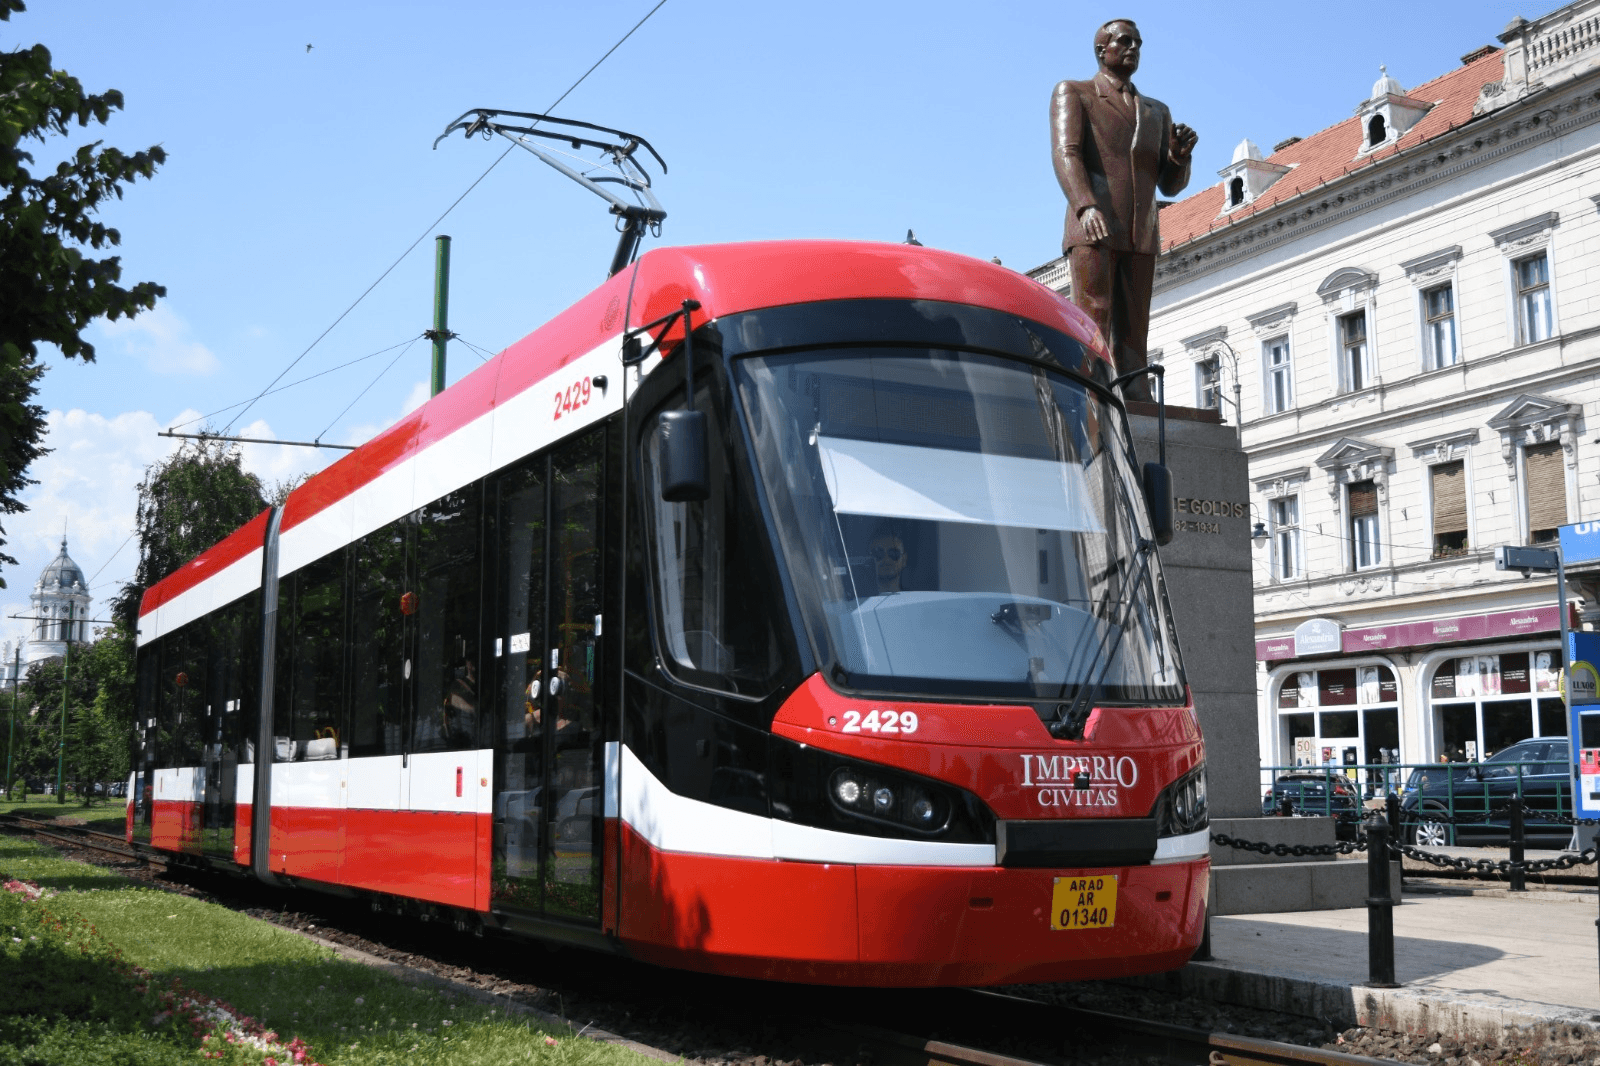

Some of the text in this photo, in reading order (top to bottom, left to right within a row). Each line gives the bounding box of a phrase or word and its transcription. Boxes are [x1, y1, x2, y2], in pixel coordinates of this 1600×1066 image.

[554, 376, 591, 421] 2429
[1173, 498, 1187, 513] E
[1174, 520, 1219, 534] 62-1934
[1300, 632, 1334, 644] Alexandria
[842, 710, 918, 734] 2429
[1020, 754, 1138, 788] IMPERIO
[1038, 789, 1117, 806] CIVITAS
[1069, 879, 1104, 891] ARAD
[1077, 892, 1094, 906] AR
[1060, 907, 1107, 927] 01340
